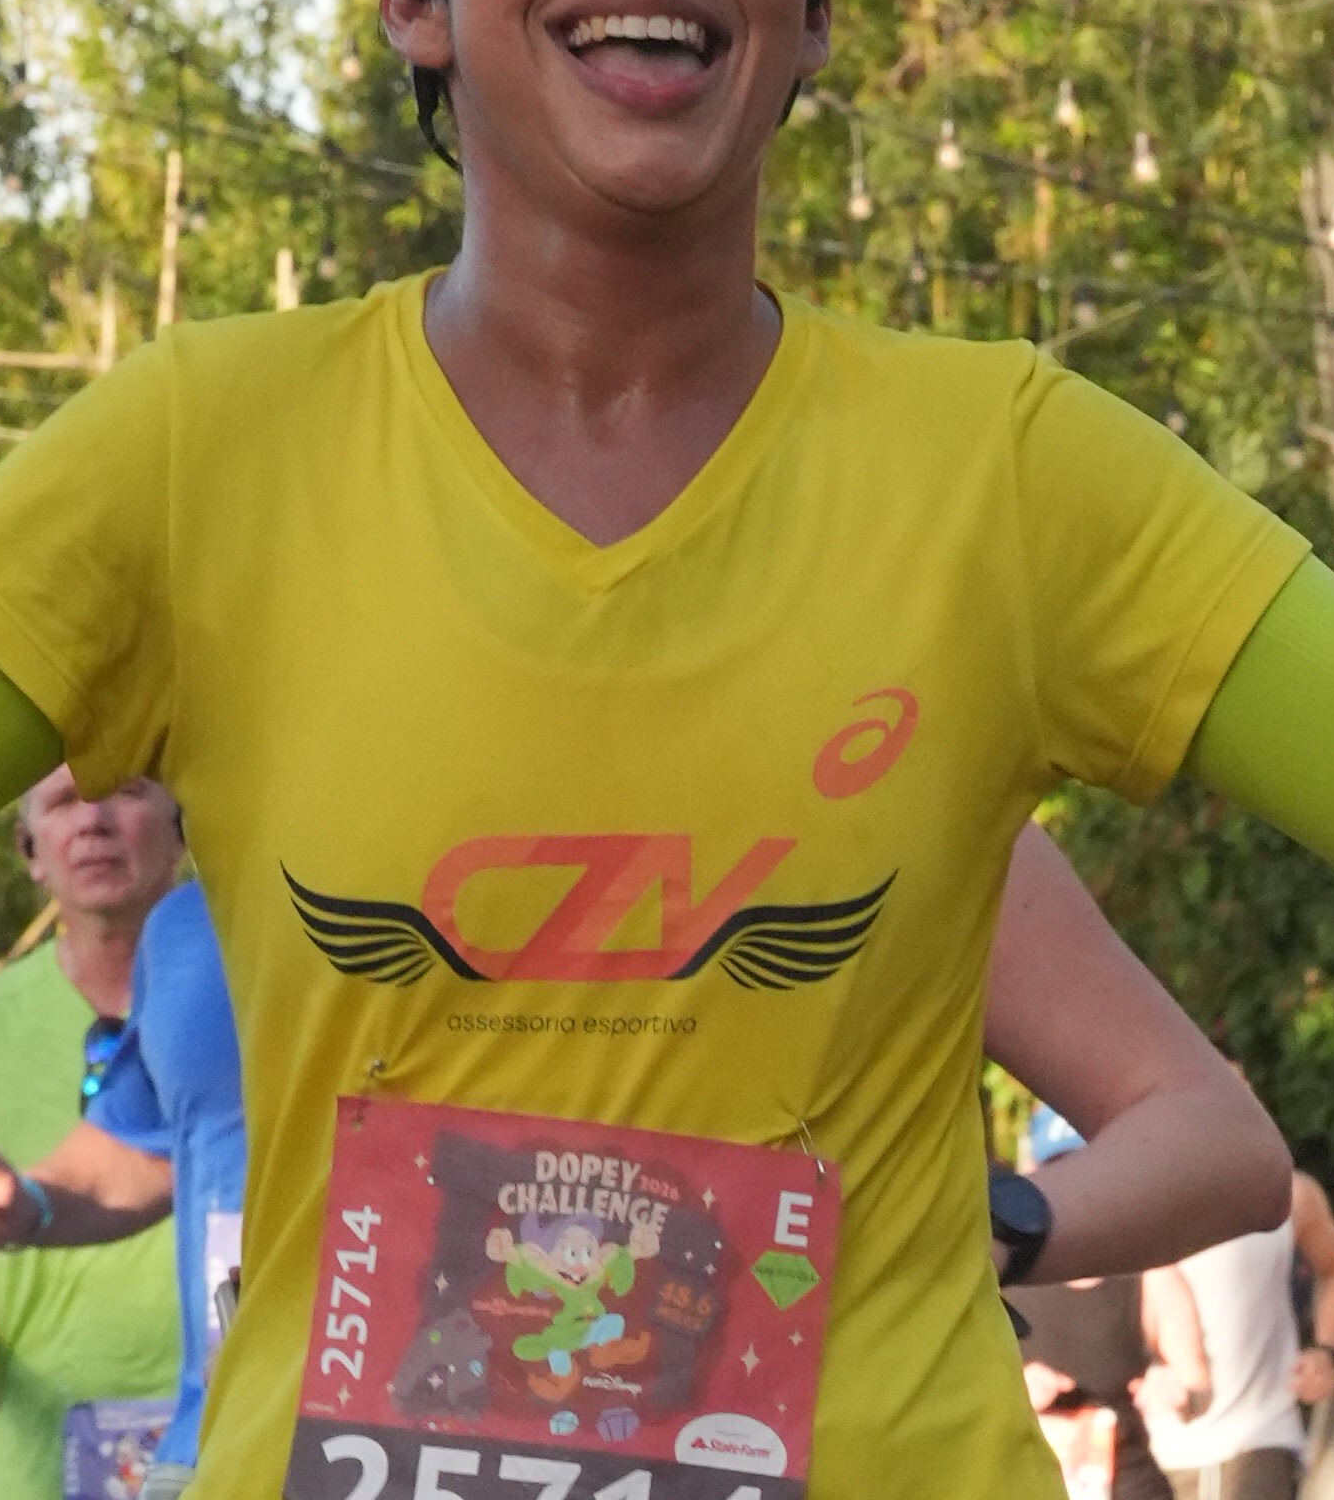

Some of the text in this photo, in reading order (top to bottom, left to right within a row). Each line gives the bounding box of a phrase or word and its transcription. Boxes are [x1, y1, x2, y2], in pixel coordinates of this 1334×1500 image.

[447, 1013, 698, 1038] assessoria esportiva
[535, 1151, 642, 1193] DOPEY
[497, 1182, 670, 1235] CHALLENGE
[774, 1191, 814, 1248] E
[321, 1204, 382, 1382] 25714
